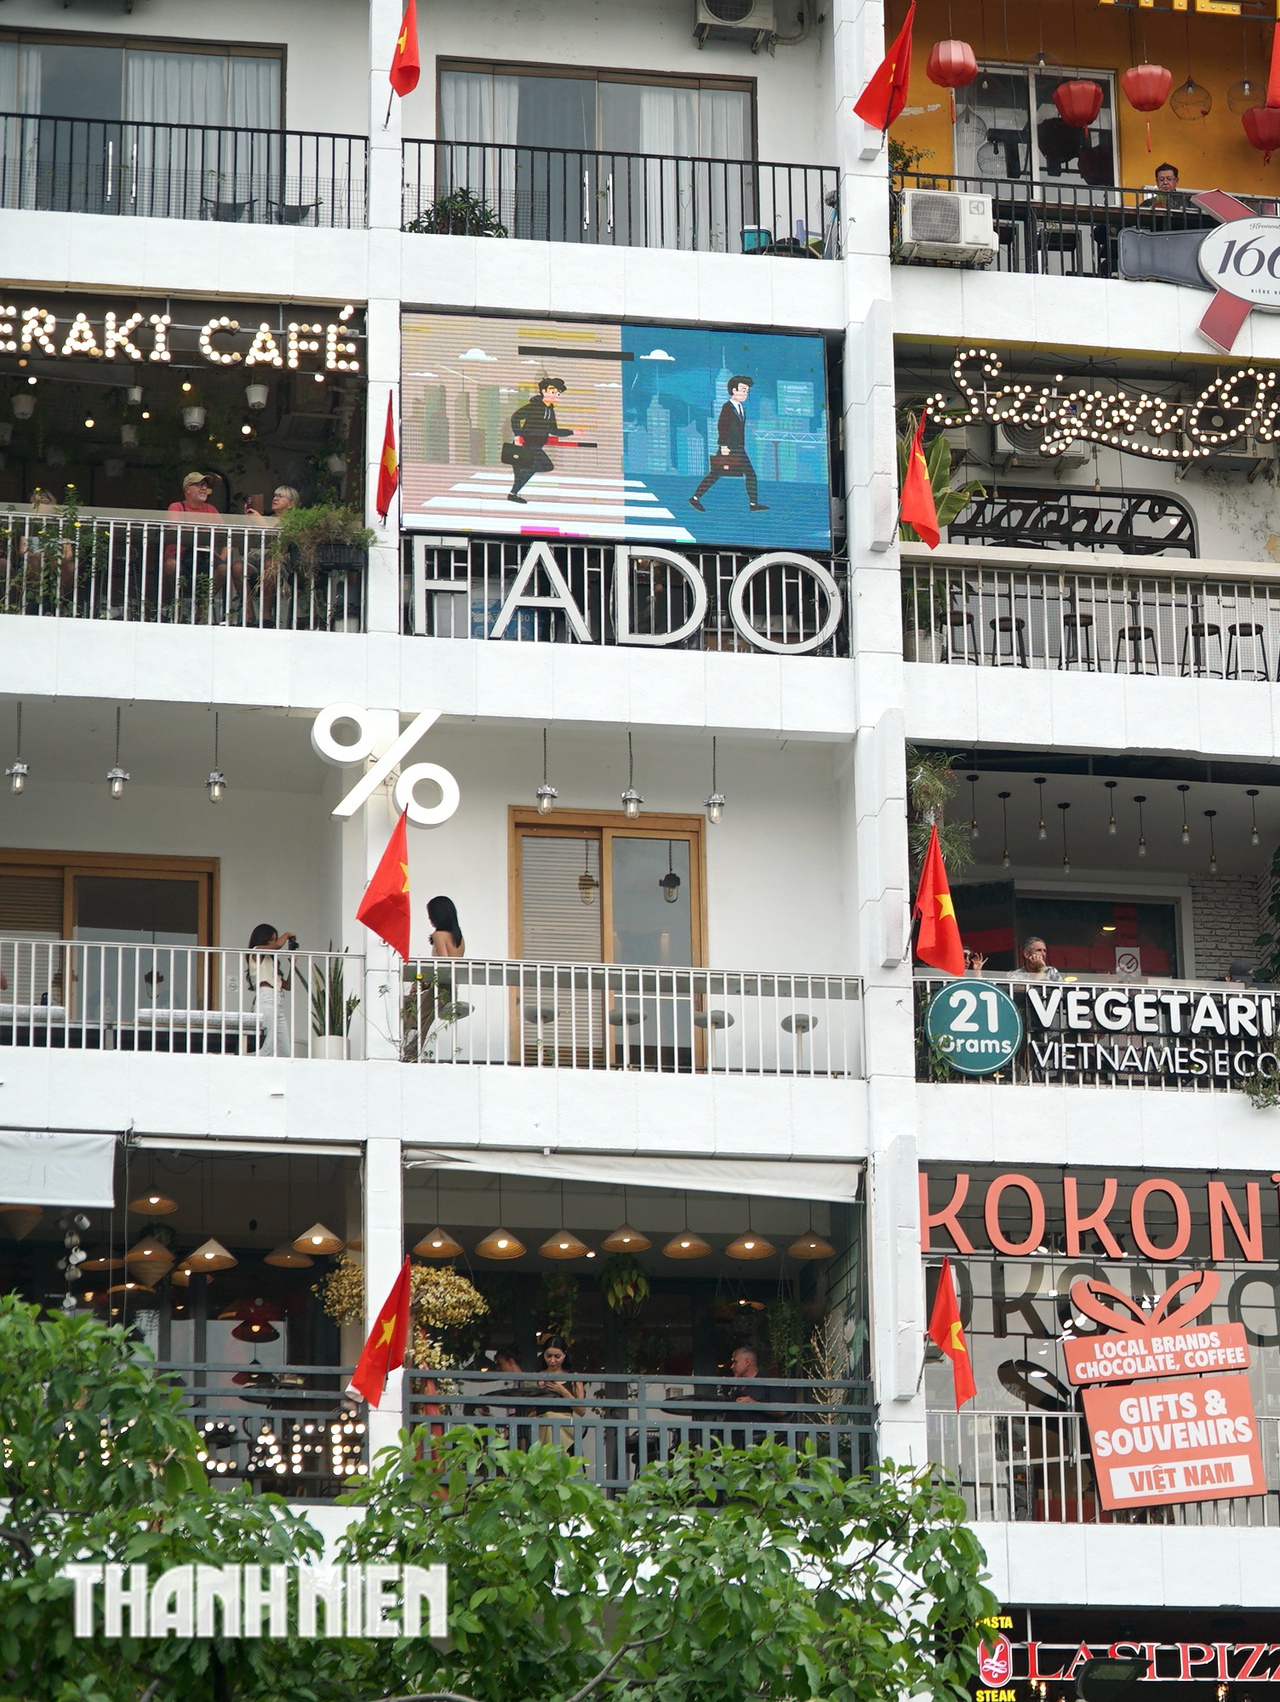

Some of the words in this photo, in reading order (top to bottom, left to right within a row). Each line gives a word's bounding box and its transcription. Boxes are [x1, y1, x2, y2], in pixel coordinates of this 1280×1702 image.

[199, 303, 363, 373] CAFÉ
[412, 534, 843, 655] FADO
[948, 989, 1000, 1034] 21
[1031, 1039, 1230, 1077] VIETNAMESE
[1075, 1354, 1181, 1379] CHOCOLATE,
[1184, 1347, 1246, 1369] COFFEE
[1093, 1339, 1149, 1360] LOCAL
[1151, 1331, 1221, 1354] BRANDS
[1119, 1391, 1198, 1425] GIFTS
[1203, 1389, 1228, 1417] &
[1093, 1415, 1254, 1457] SOUVENIRS
[1128, 1464, 1177, 1493] VIỆT
[1183, 1461, 1235, 1488] NAM
[975, 1615, 1014, 1630] ASTA
[975, 1689, 1016, 1702] STEAK
